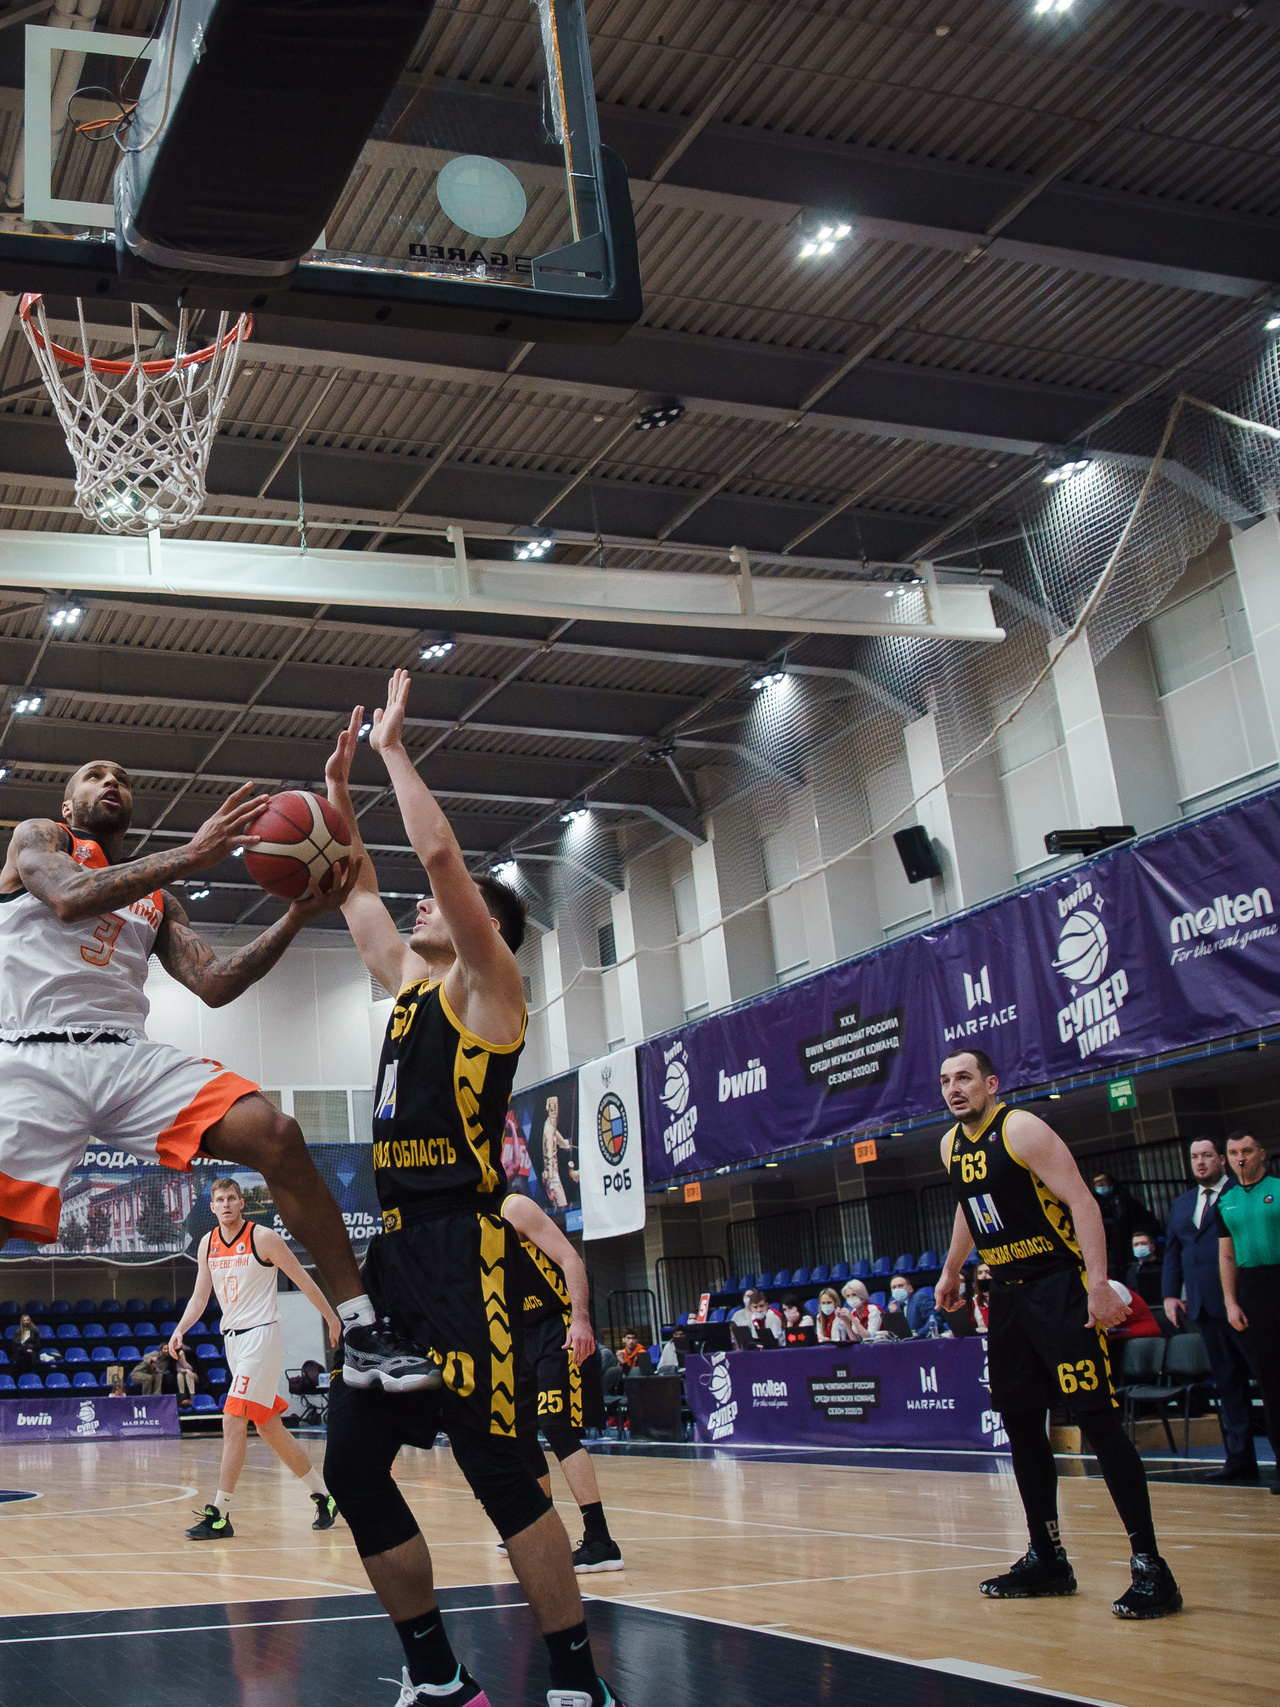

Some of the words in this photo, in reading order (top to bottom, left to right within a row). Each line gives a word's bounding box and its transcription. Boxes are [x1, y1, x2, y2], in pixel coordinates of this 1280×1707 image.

[1058, 880, 1093, 918] bwin
[1170, 887, 1274, 944] molten
[80, 912, 126, 966] 3
[1170, 947, 1194, 966] For
[1193, 940, 1214, 958] the
[1213, 929, 1240, 951] real
[1239, 924, 1279, 950] game
[1057, 969, 1130, 1044] СУПЕР
[823, 1028, 865, 1050] ЧЕМПИОНАТ
[865, 1017, 899, 1037] РОССИИ
[943, 1005, 1018, 1042] WARFACE
[1076, 1014, 1121, 1059] ЛИГА
[810, 1058, 831, 1074] СРЕДИ
[830, 1047, 866, 1066] МУЖСКИХ
[865, 1036, 900, 1055] КОМАНД
[718, 1059, 767, 1102] bwin
[828, 1070, 852, 1085] СЕЗОН
[663, 1105, 698, 1155] СУПЕР
[77, 1151, 139, 1168] РОДА
[392, 1138, 457, 1168] ОБЛАСТЬ
[672, 1137, 696, 1167] ЛИГА
[961, 1150, 988, 1183] 63
[603, 1168, 632, 1196] РФБ
[1010, 1236, 1055, 1259] ОБЛАСТЬ
[222, 1276, 238, 1304] 13
[233, 1375, 250, 1395] 13
[752, 1379, 788, 1397] molten
[1057, 1359, 1099, 1394] 63
[537, 1390, 563, 1415] 25
[707, 1400, 738, 1431] СУПЕР
[906, 1399, 955, 1409] WARFACE
[17, 1412, 53, 1426] bwin
